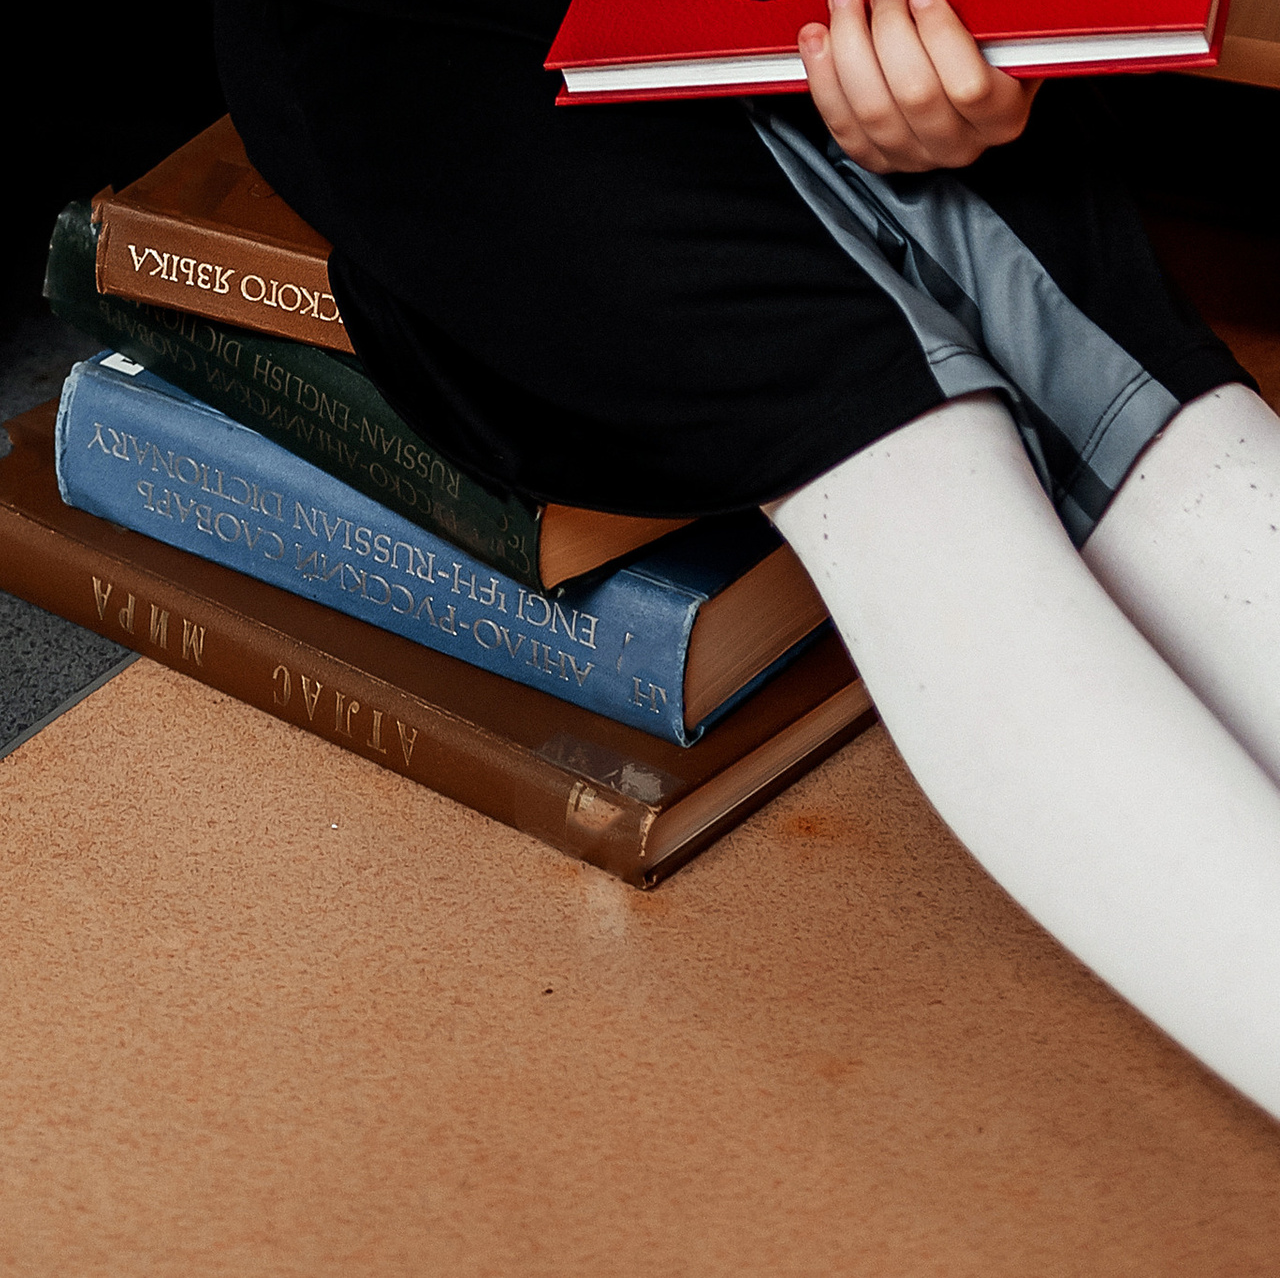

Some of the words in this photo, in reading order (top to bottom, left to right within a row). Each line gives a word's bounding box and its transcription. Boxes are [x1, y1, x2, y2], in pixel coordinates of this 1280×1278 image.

[128, 245, 235, 295] ЯЗЫКА
[240, 274, 344, 325] СКОГО
[88, 422, 284, 521] DICTIONARY
[252, 353, 461, 499] RUSSIAN-ENGLISH
[137, 478, 286, 562] СЛОВАРЬ
[91, 575, 207, 667] МИРА
[295, 544, 593, 687] АНГЛО-РУССКИЙ
[273, 665, 421, 766] АТЛАС
